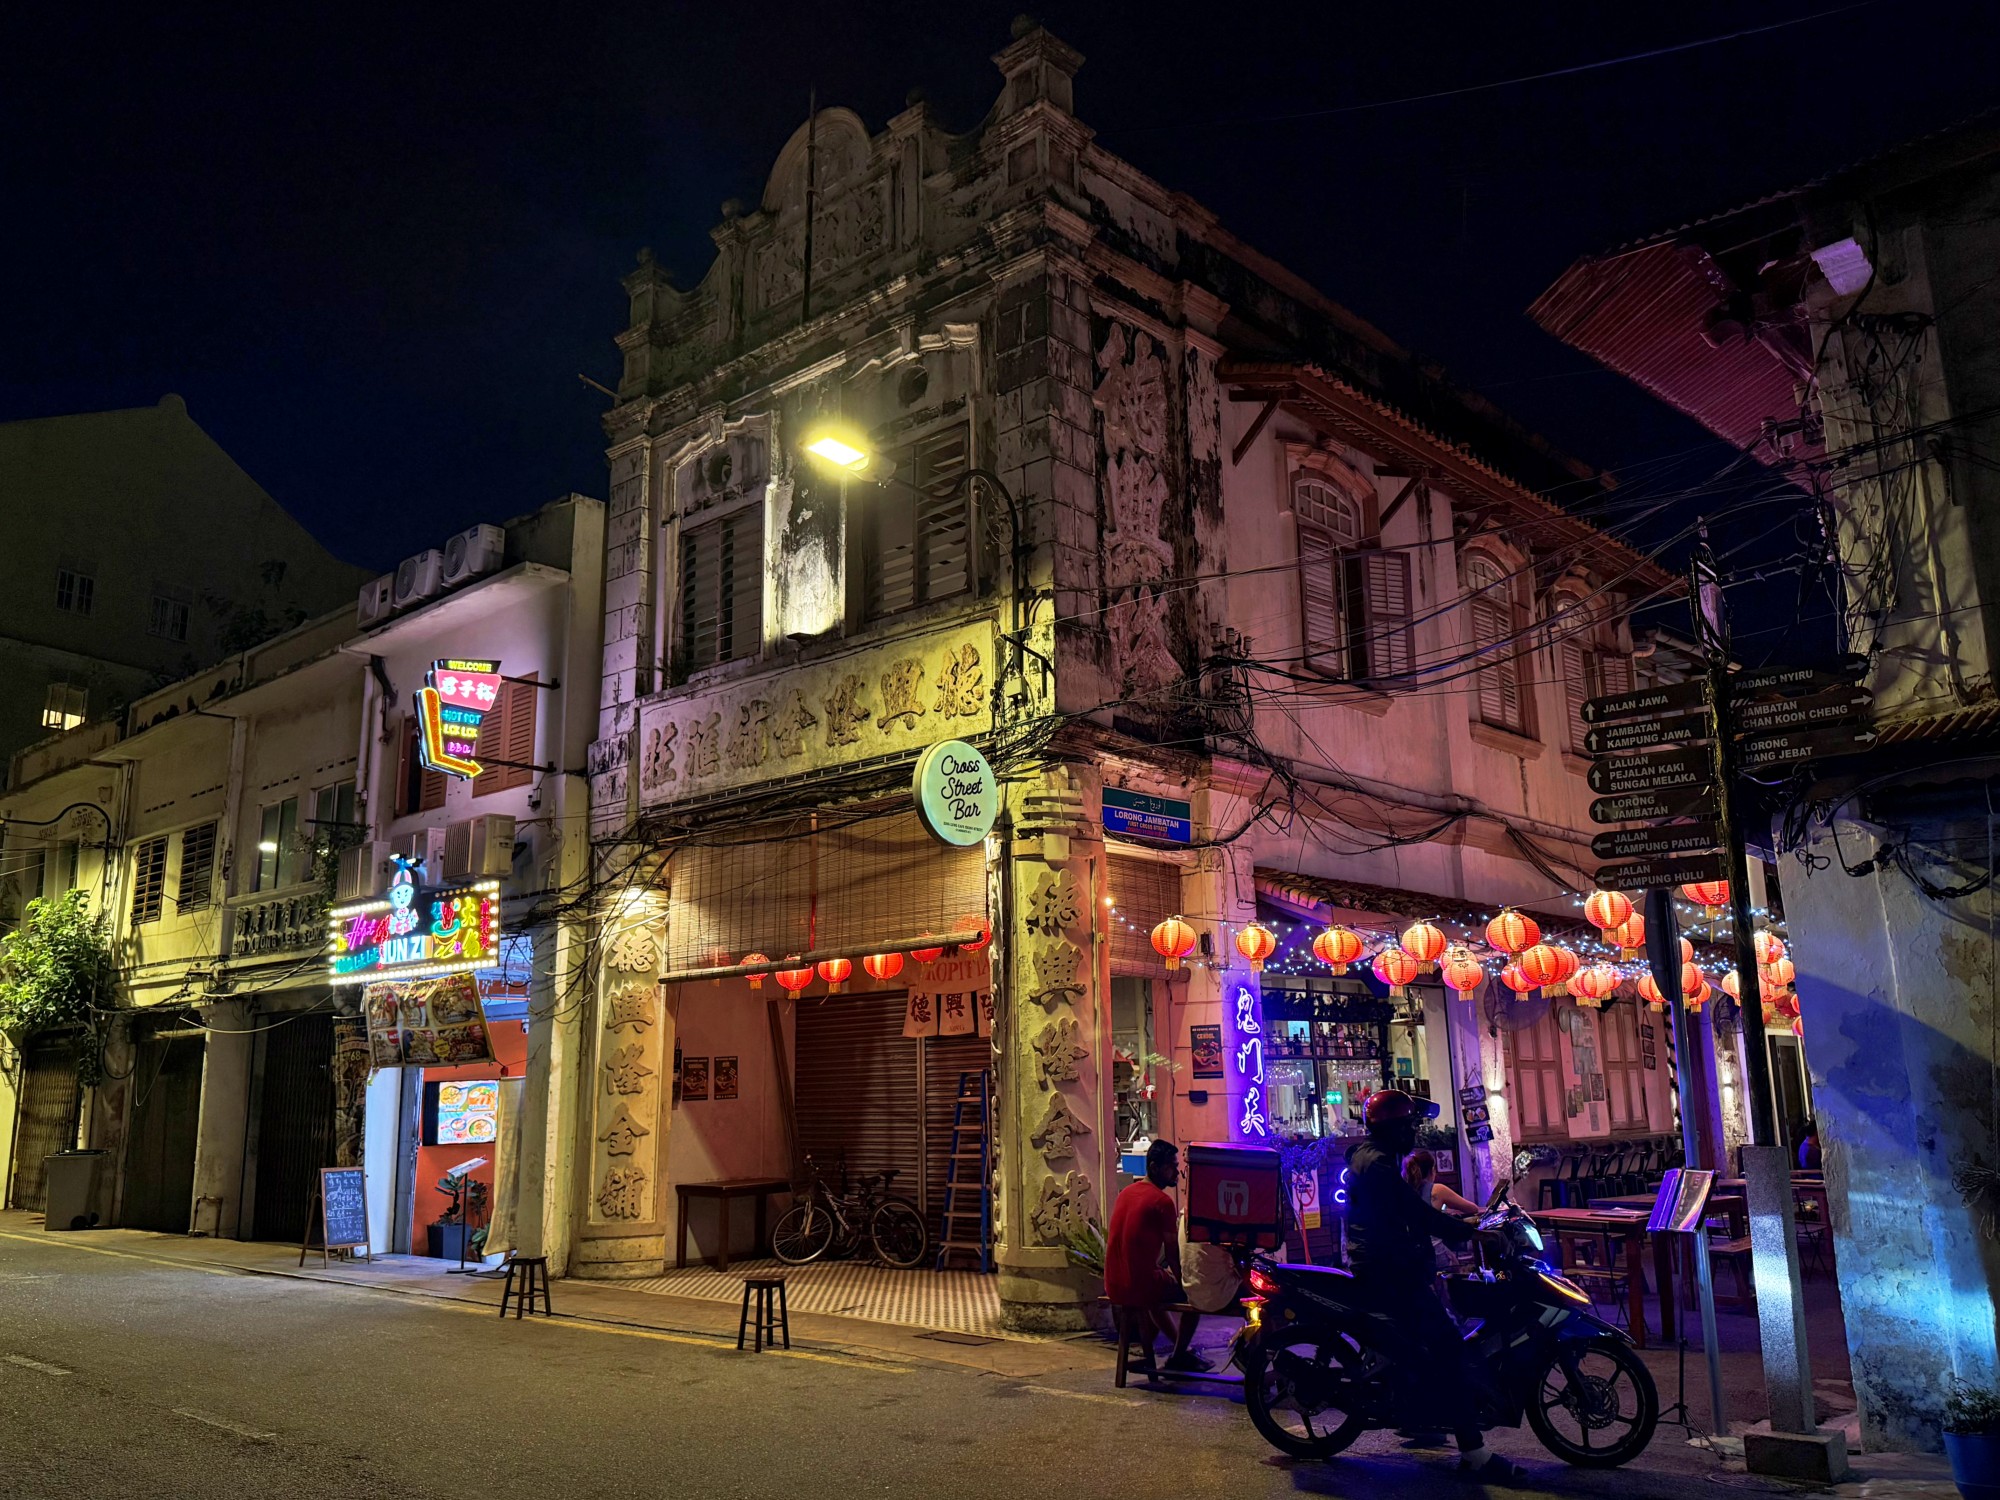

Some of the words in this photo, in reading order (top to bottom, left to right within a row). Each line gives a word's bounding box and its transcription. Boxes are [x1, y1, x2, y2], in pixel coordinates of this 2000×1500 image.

[448, 660, 492, 673] WELCOME
[1735, 676, 1777, 690] PADANG
[1780, 669, 1814, 683] NYIRU
[1603, 700, 1636, 713] JALAN
[1639, 695, 1668, 707] JAWA
[1742, 701, 1797, 717] JAMBATAN
[1743, 717, 1772, 728] CHAN
[1775, 711, 1806, 724] KOON
[1809, 705, 1848, 718] CHENG
[1606, 722, 1660, 738] JAMBATAN
[1607, 734, 1658, 748] KAMPUNG
[1661, 729, 1691, 740] JAWA
[1744, 738, 1788, 752] LORONG
[1609, 756, 1648, 769] LALUAN
[1746, 752, 1776, 764] HANG
[1779, 746, 1813, 759] JEBAT
[941, 755, 980, 776] Cross
[1610, 766, 1655, 780] PEJALAN
[1658, 762, 1685, 774] KAKI
[941, 777, 982, 799] Street
[1610, 779, 1649, 790] SUNGAI
[1653, 773, 1697, 786] MELAKA
[948, 798, 981, 820] Bar
[1611, 796, 1655, 808] LORONG
[1114, 810, 1142, 822] LORONG
[1143, 815, 1179, 829] JAMBATAN
[1613, 806, 1668, 820] JAMBATAN
[1614, 832, 1648, 843] JALAN
[1615, 842, 1668, 854] KAMPUNG
[1672, 836, 1710, 849] PANTAI
[1617, 865, 1650, 876] JALAN
[1618, 875, 1670, 887] KAMPUNG
[1675, 871, 1704, 881] HULU
[381, 937, 408, 964] JUN
